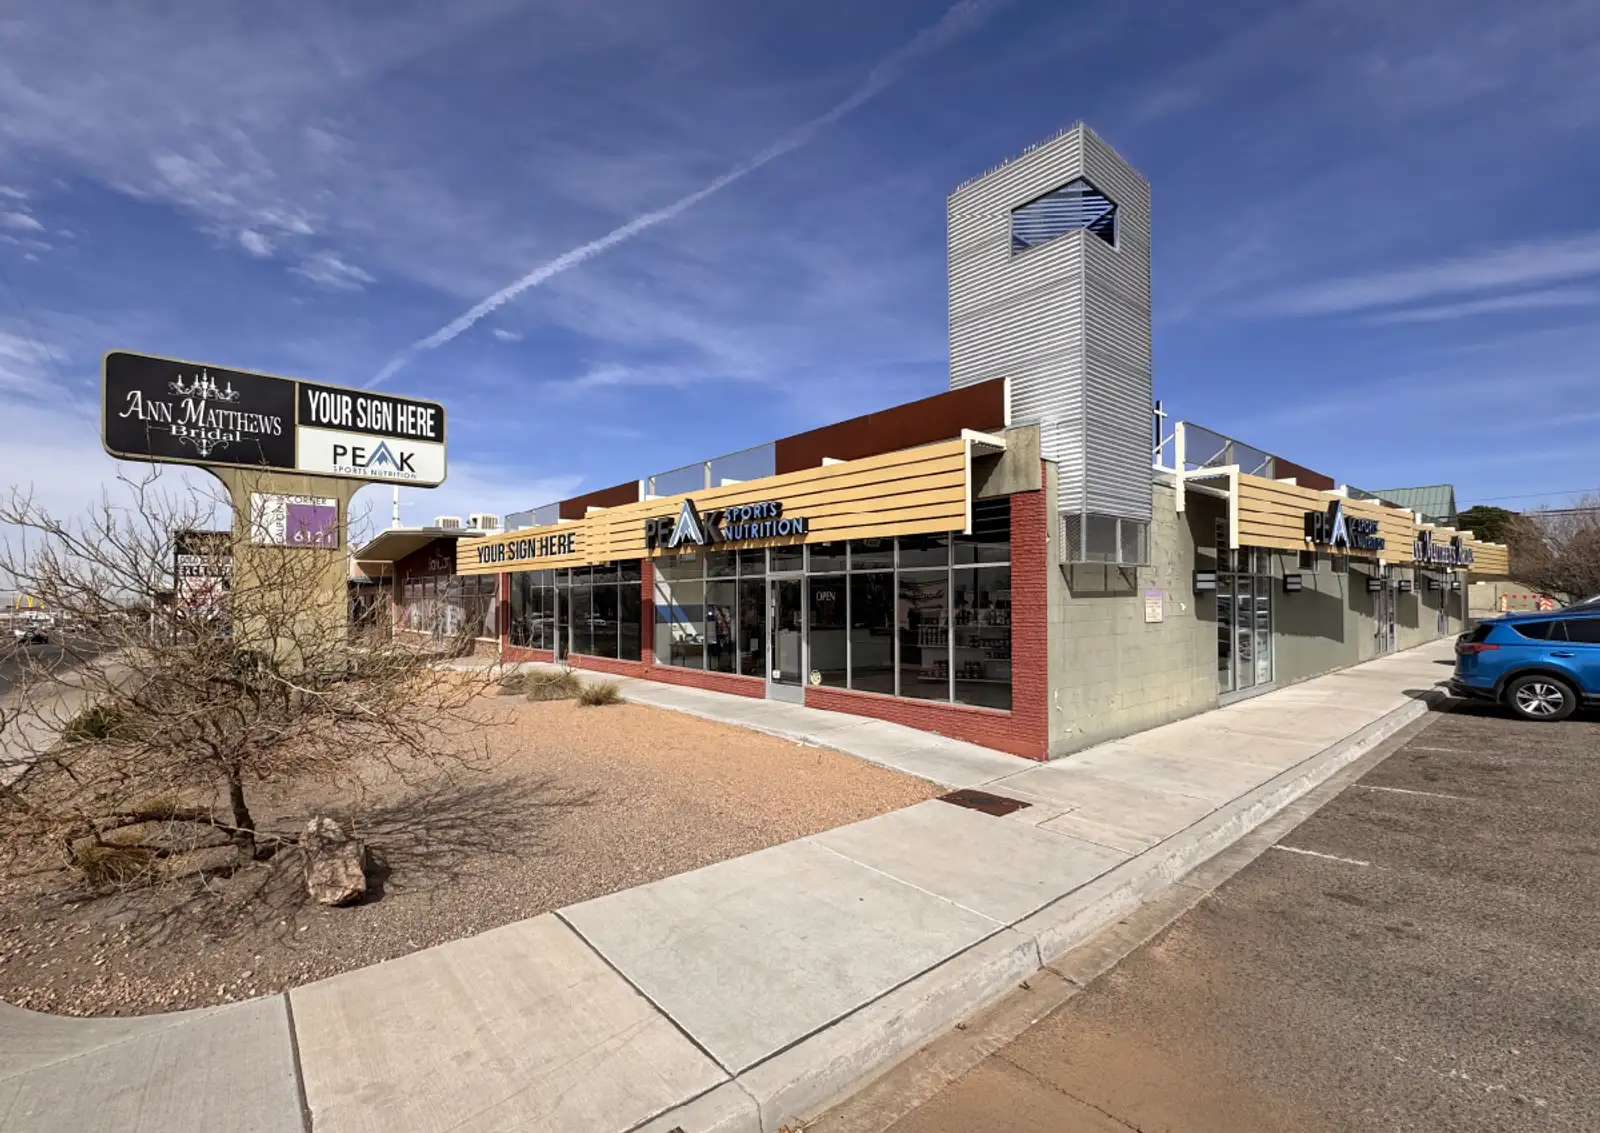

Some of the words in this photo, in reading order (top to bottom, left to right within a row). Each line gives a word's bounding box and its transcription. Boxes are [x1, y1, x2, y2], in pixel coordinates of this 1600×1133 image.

[308, 389, 352, 427] YOUR
[356, 397, 393, 432] SIGN
[397, 403, 436, 438] HERE
[170, 425, 242, 442] Bridal
[333, 440, 416, 473] PEAK
[333, 465, 368, 476] SPORTS
[371, 469, 417, 480] NUTRITION
[645, 498, 726, 549] PEAK
[725, 502, 781, 523] SPORTS
[294, 530, 332, 543] 6121
[724, 517, 806, 541] NUTRITION
[477, 543, 505, 564] YOUR
[508, 538, 536, 561] SIGN
[540, 532, 576, 557] HERE
[816, 591, 836, 601] OPEN
